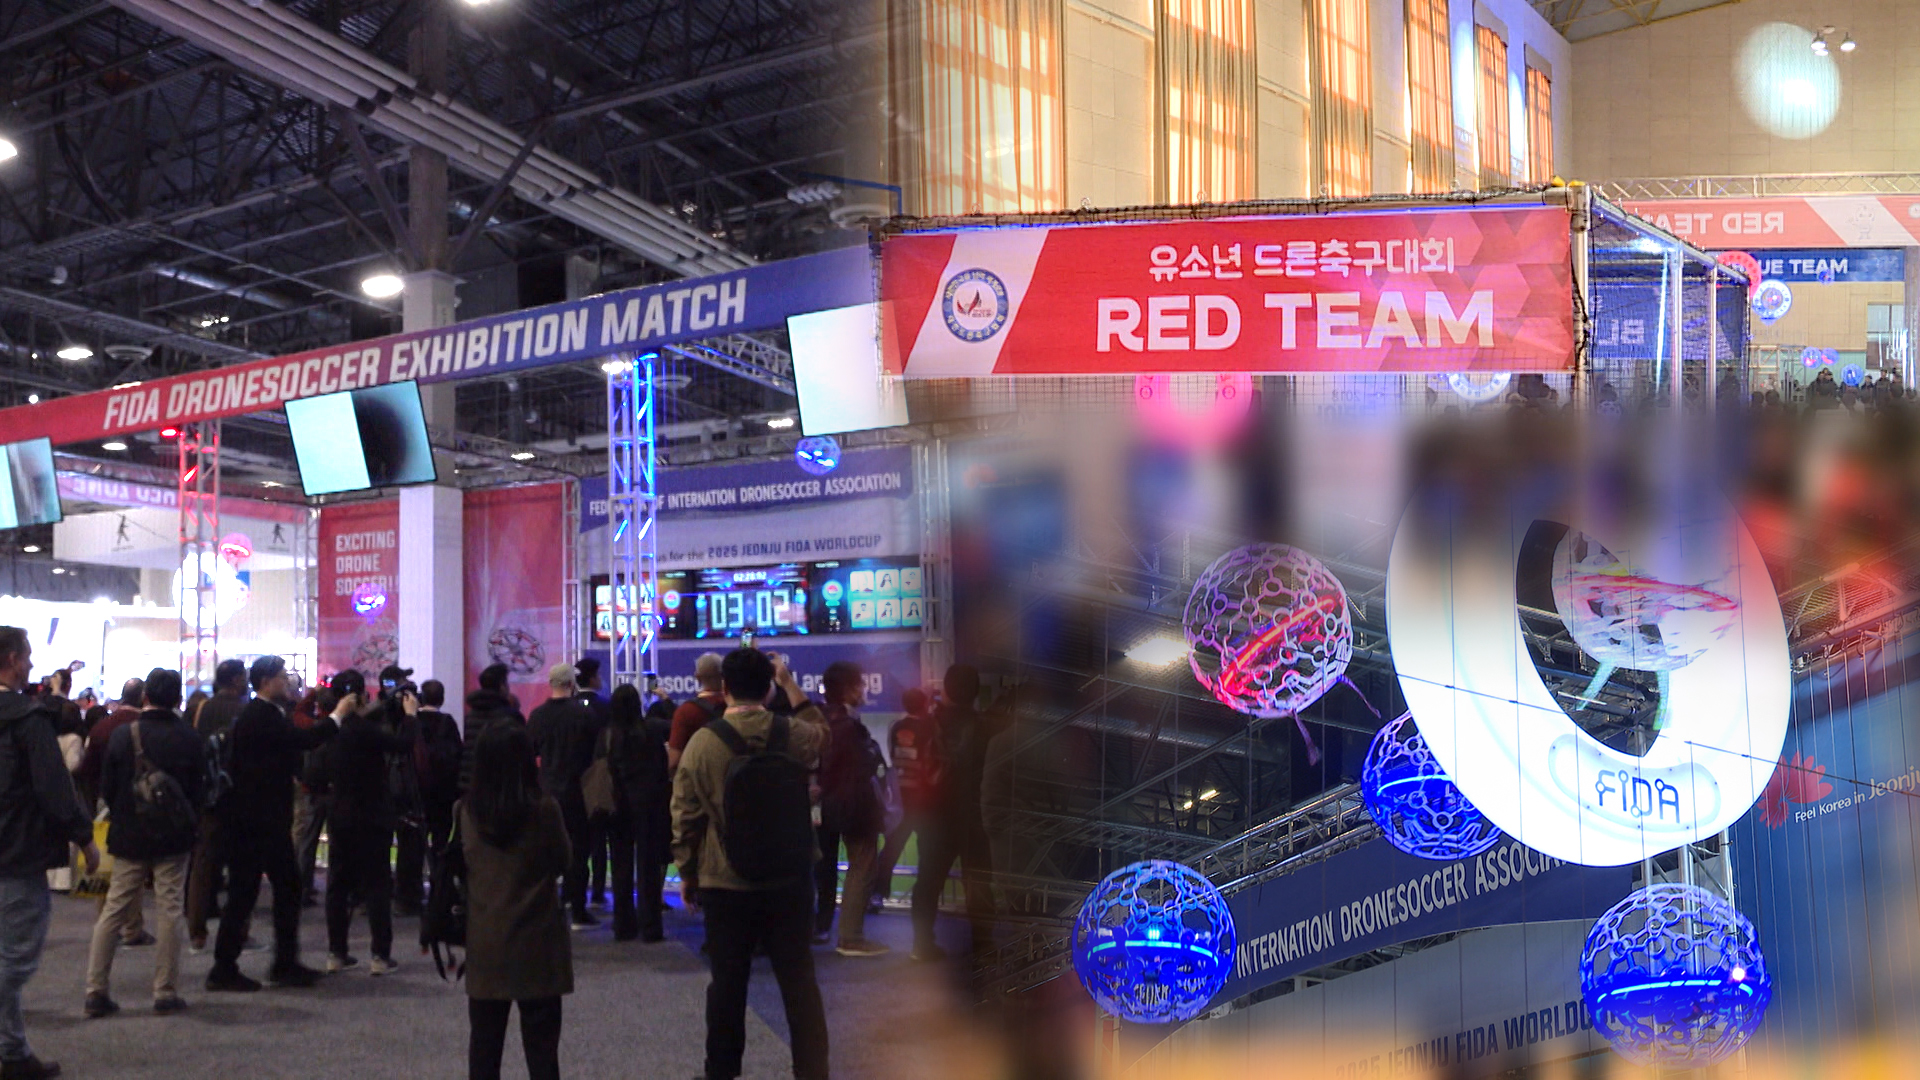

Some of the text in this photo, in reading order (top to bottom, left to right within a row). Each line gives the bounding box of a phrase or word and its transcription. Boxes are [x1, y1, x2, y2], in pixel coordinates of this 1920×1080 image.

[1149, 236, 1454, 282] 유소년 드론축구대회
[1788, 258, 1848, 274] TEAM
[1096, 289, 1495, 352] RED TEAM
[103, 277, 747, 431] FIDA DRONESOCCER EXHIBITION MATCH
[668, 488, 736, 510] INTERNATION
[740, 479, 821, 504] DRONESOCCER
[824, 471, 901, 496] ASSOCIATION
[335, 529, 396, 552] EXCITING
[785, 539, 811, 553] FIDA
[814, 534, 882, 552] WORLDCUP
[335, 553, 381, 574] DRONE
[1595, 769, 1680, 824] FIDA
[1794, 806, 1816, 824] Feel
[1819, 796, 1852, 816] Korea
[1853, 791, 1866, 804] in
[1236, 910, 1336, 979] INTERNATION
[1339, 862, 1469, 943] DRONESOCCER
[1456, 1023, 1499, 1064] FIDA
